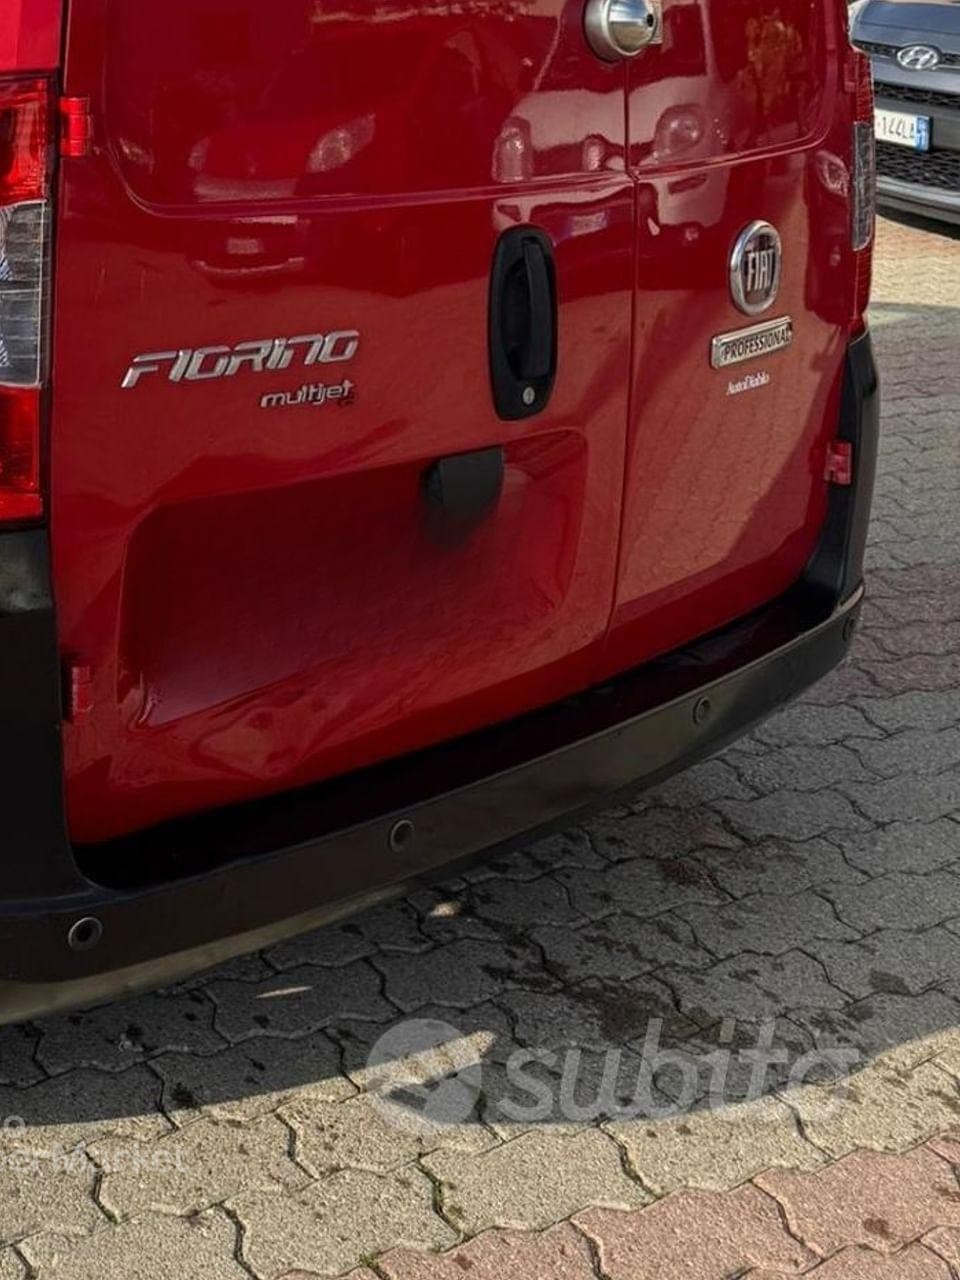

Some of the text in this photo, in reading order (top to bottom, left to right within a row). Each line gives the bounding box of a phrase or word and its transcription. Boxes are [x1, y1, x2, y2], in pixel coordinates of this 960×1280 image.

[746, 248, 776, 293] FIAT
[120, 330, 360, 389] FIORINO
[723, 326, 790, 361] PROFESSIONAL
[260, 378, 356, 408] multijet
